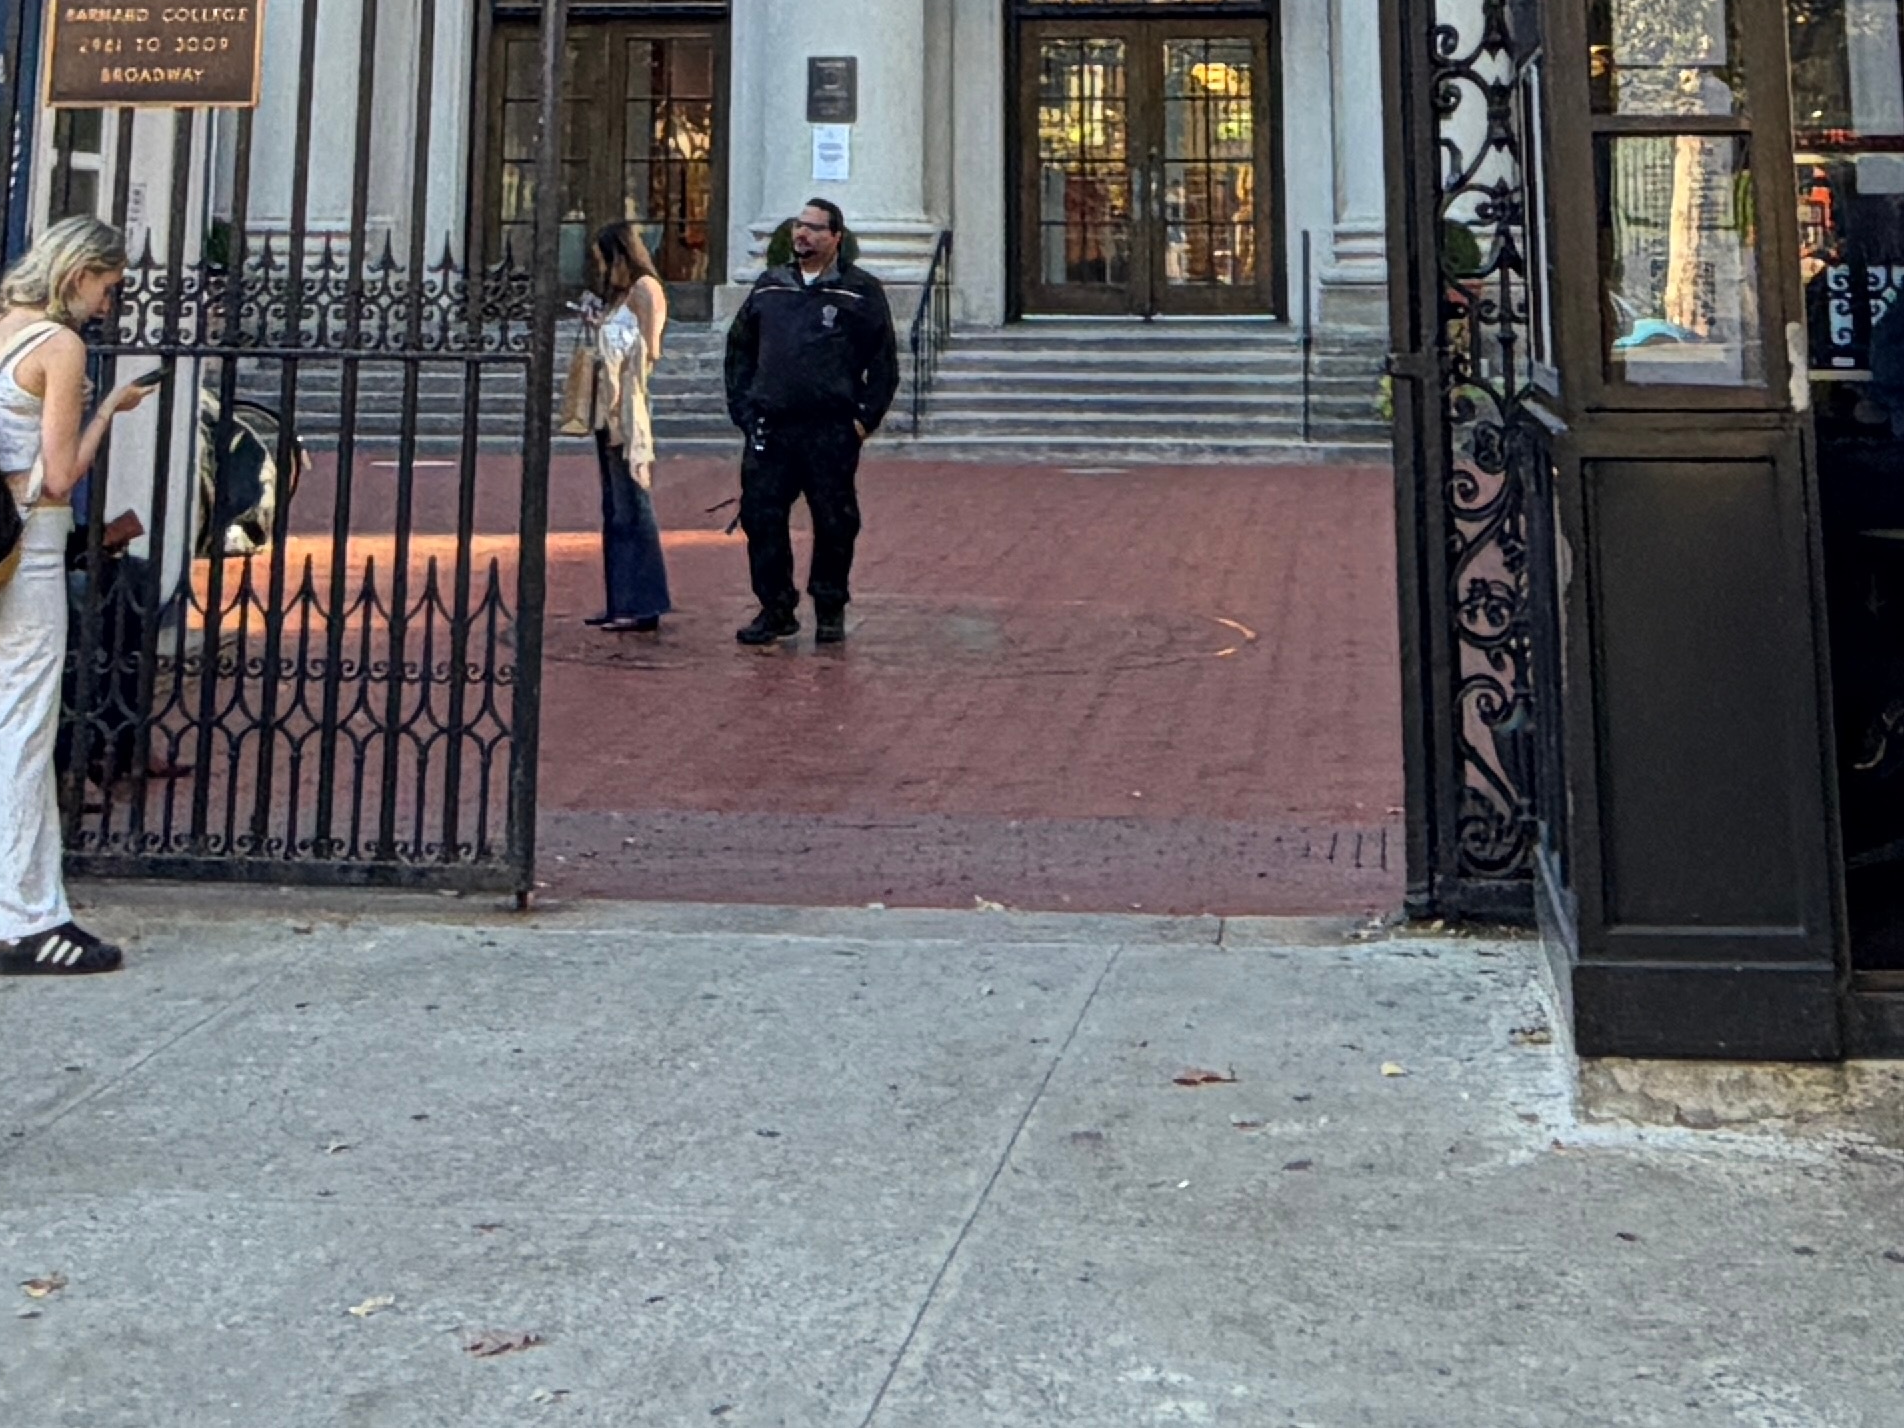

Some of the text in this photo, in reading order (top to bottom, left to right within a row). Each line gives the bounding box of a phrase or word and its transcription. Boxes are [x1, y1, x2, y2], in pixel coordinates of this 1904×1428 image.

[65, 6, 249, 24] BARNARD COLLEGE
[99, 66, 206, 84] BROADWAY
